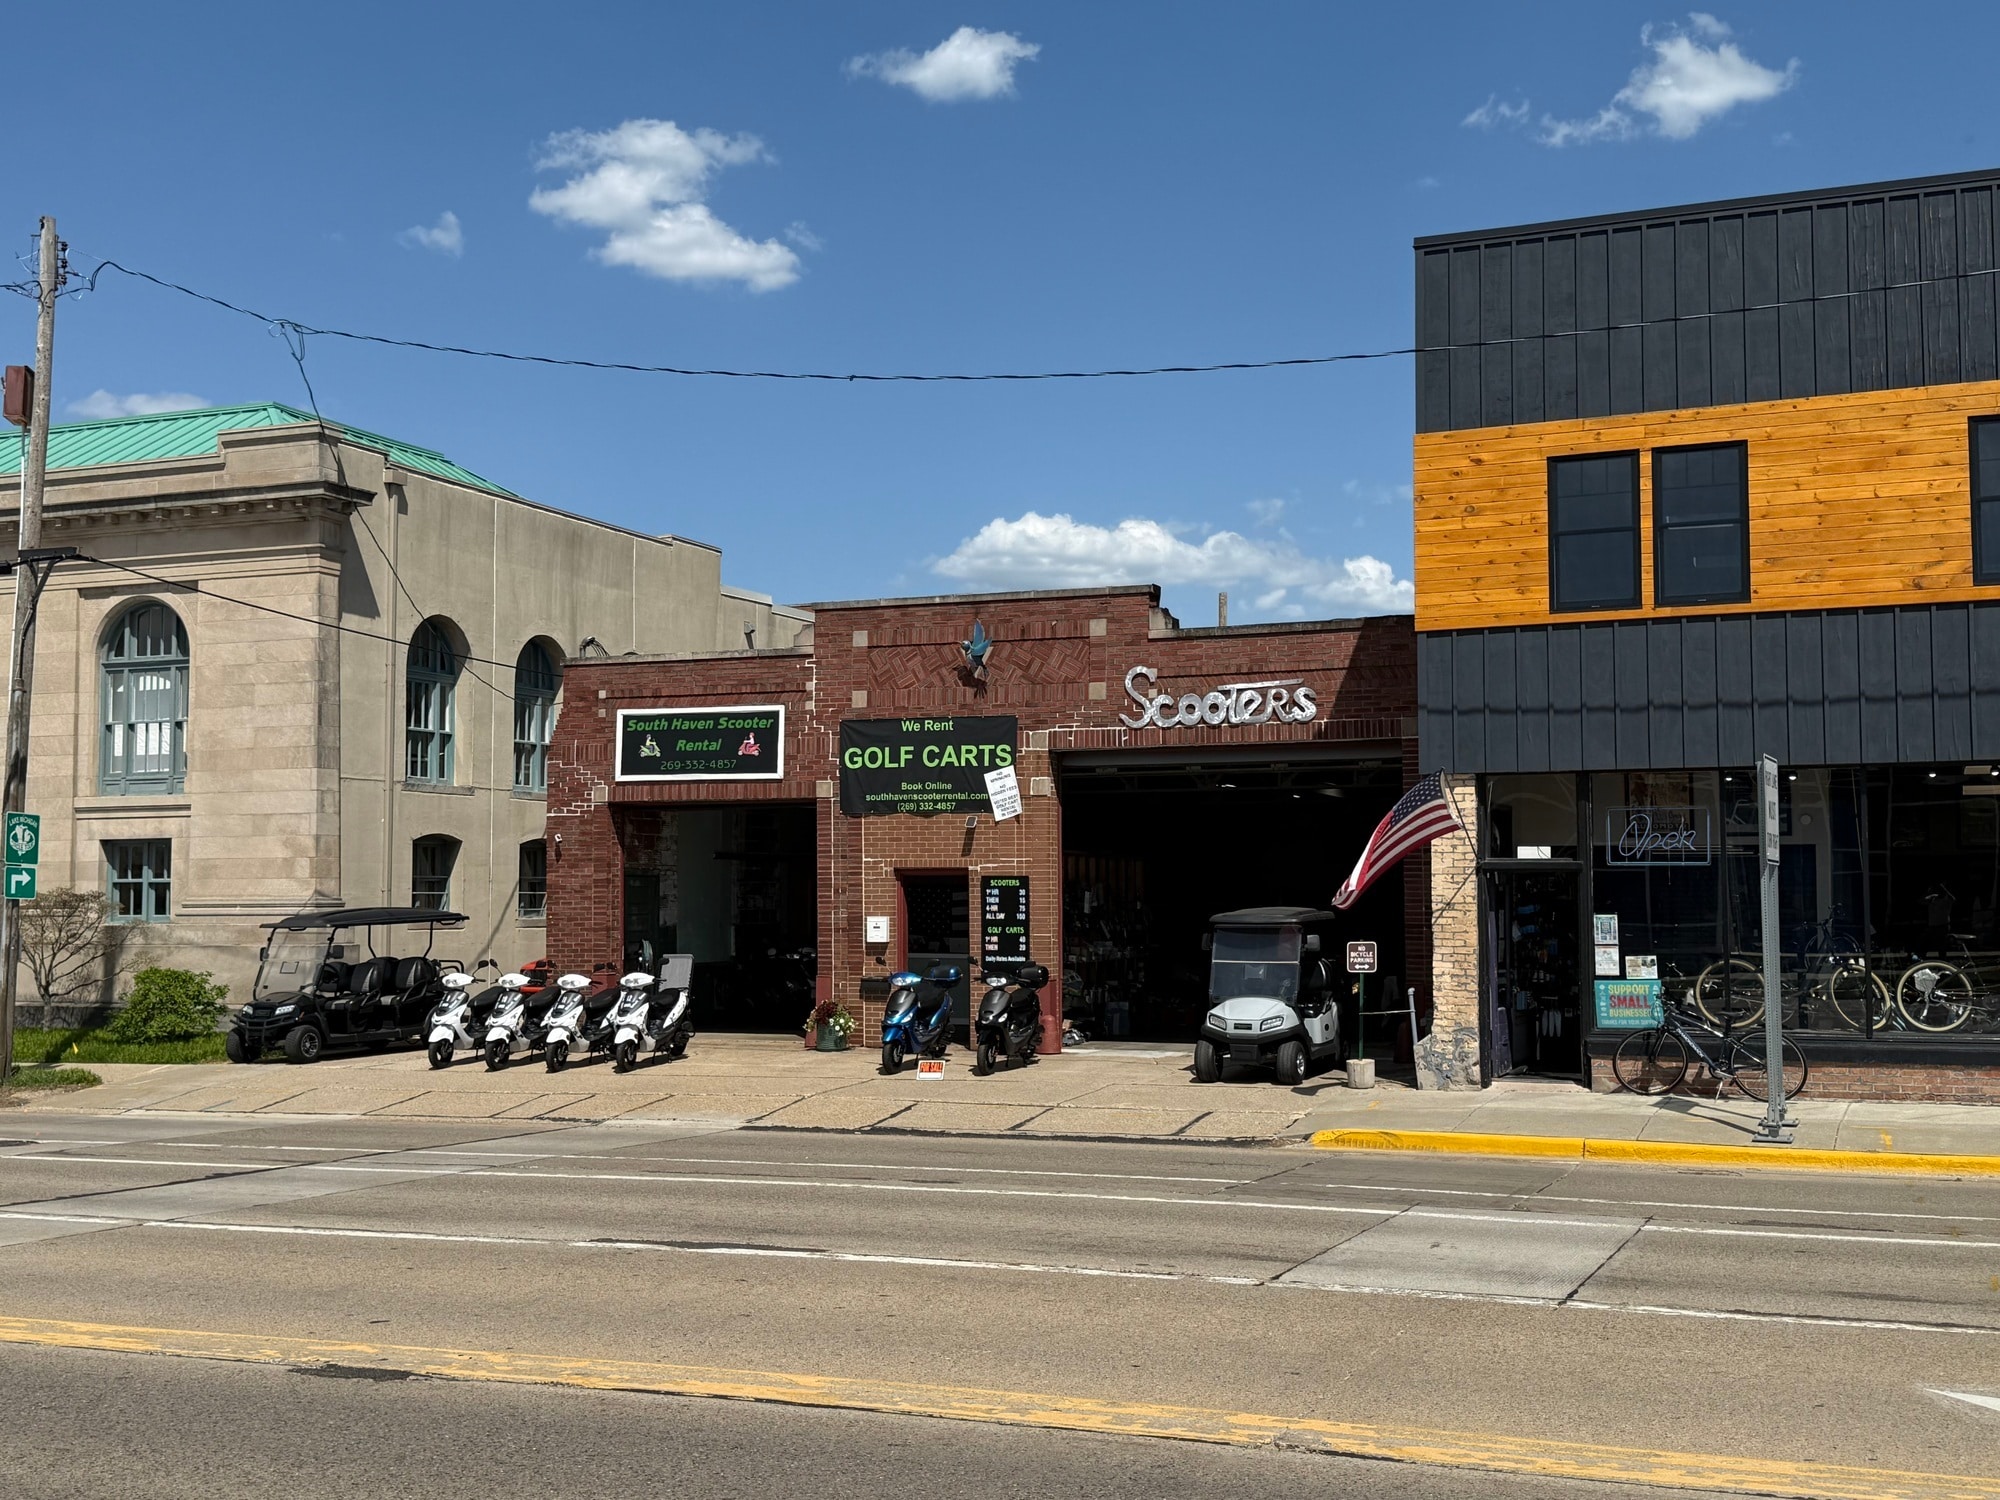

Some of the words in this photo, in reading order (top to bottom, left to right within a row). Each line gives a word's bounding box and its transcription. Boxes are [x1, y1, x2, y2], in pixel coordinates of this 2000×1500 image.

[627, 718, 668, 731] South
[671, 718, 714, 730] Haven
[717, 717, 774, 729] Scooter
[901, 720, 921, 731] We
[925, 719, 954, 731] Rent
[676, 739, 722, 751] Rental
[844, 746, 914, 769] GOLF
[922, 744, 1012, 767] CARTS
[660, 760, 737, 770] 269-332-4857
[901, 782, 923, 790] Book
[925, 782, 953, 790] Online
[865, 793, 989, 801] southhavenscooterrental.com
[897, 802, 917, 812] (269)
[919, 802, 956, 810] 332-4857
[1619, 814, 1696, 859] Open
[1608, 984, 1650, 995] SUPPORT
[1609, 995, 1651, 1008] SMALL
